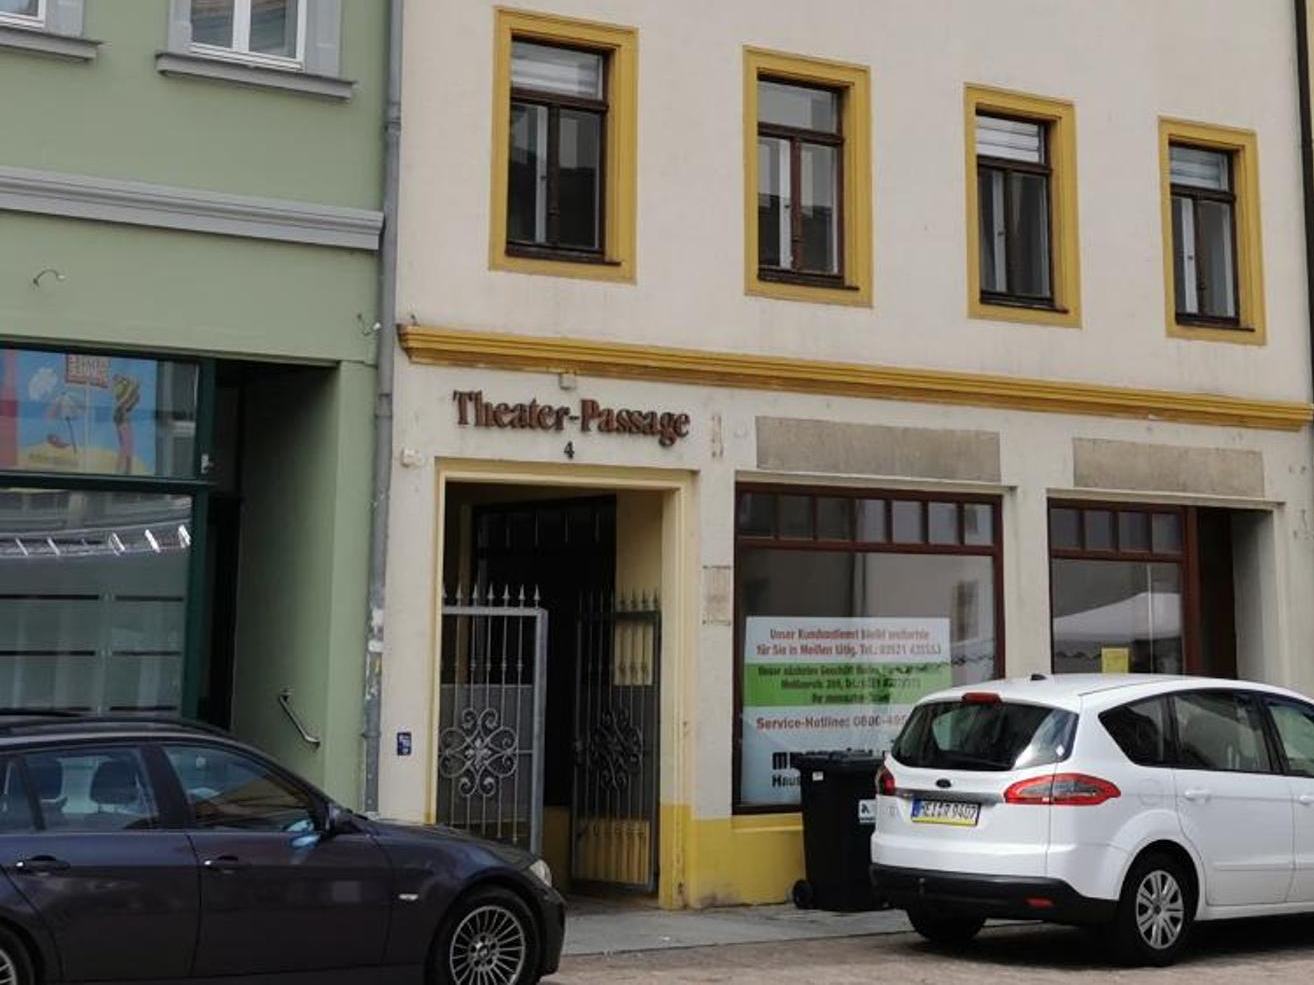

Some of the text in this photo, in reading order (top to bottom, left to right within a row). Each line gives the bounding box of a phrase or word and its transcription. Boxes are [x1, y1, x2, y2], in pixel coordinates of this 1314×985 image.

[453, 390, 691, 447] Theater-Passage
[563, 441, 575, 459] 4
[773, 644, 786, 655] Sie
[789, 644, 798, 655] in
[756, 716, 850, 730] Service-Hotline:
